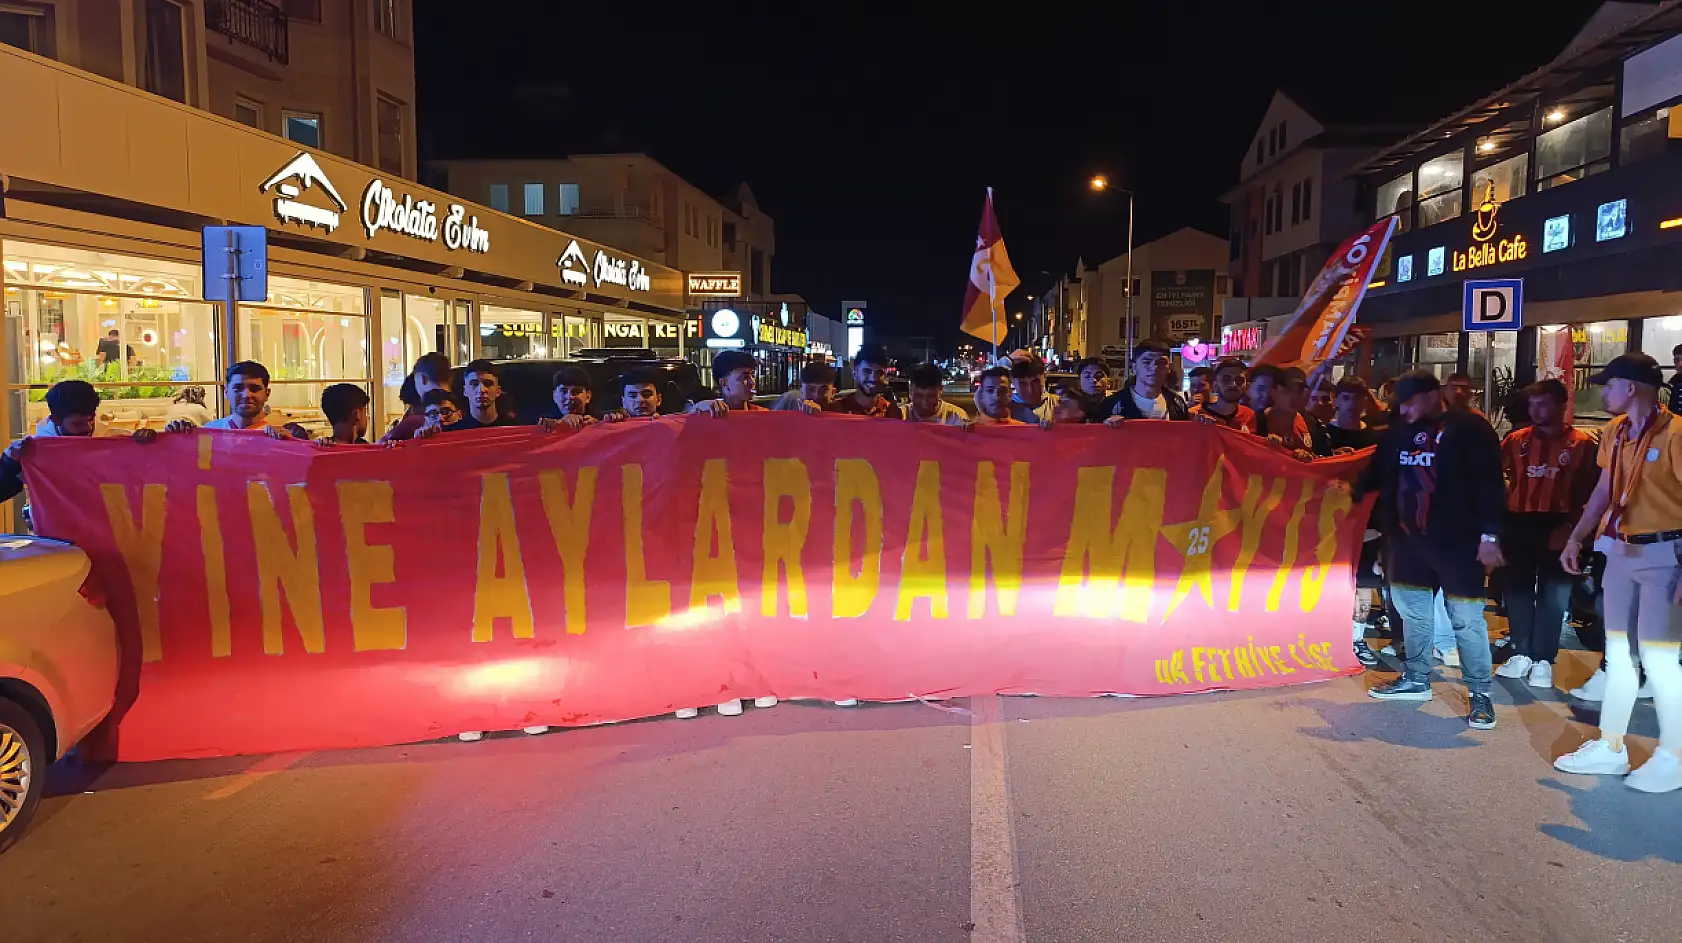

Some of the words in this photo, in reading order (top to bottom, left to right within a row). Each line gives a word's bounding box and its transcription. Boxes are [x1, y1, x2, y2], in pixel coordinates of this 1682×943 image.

[1453, 250, 1466, 272] La
[1498, 235, 1527, 262] Cafe
[690, 278, 739, 291] WAFFLE
[1480, 290, 1507, 321] D
[101, 435, 408, 663] YİNE
[470, 457, 1031, 645] AYLARDAN
[1187, 526, 1210, 556] 25
[1191, 634, 1296, 684] FETHİYE
